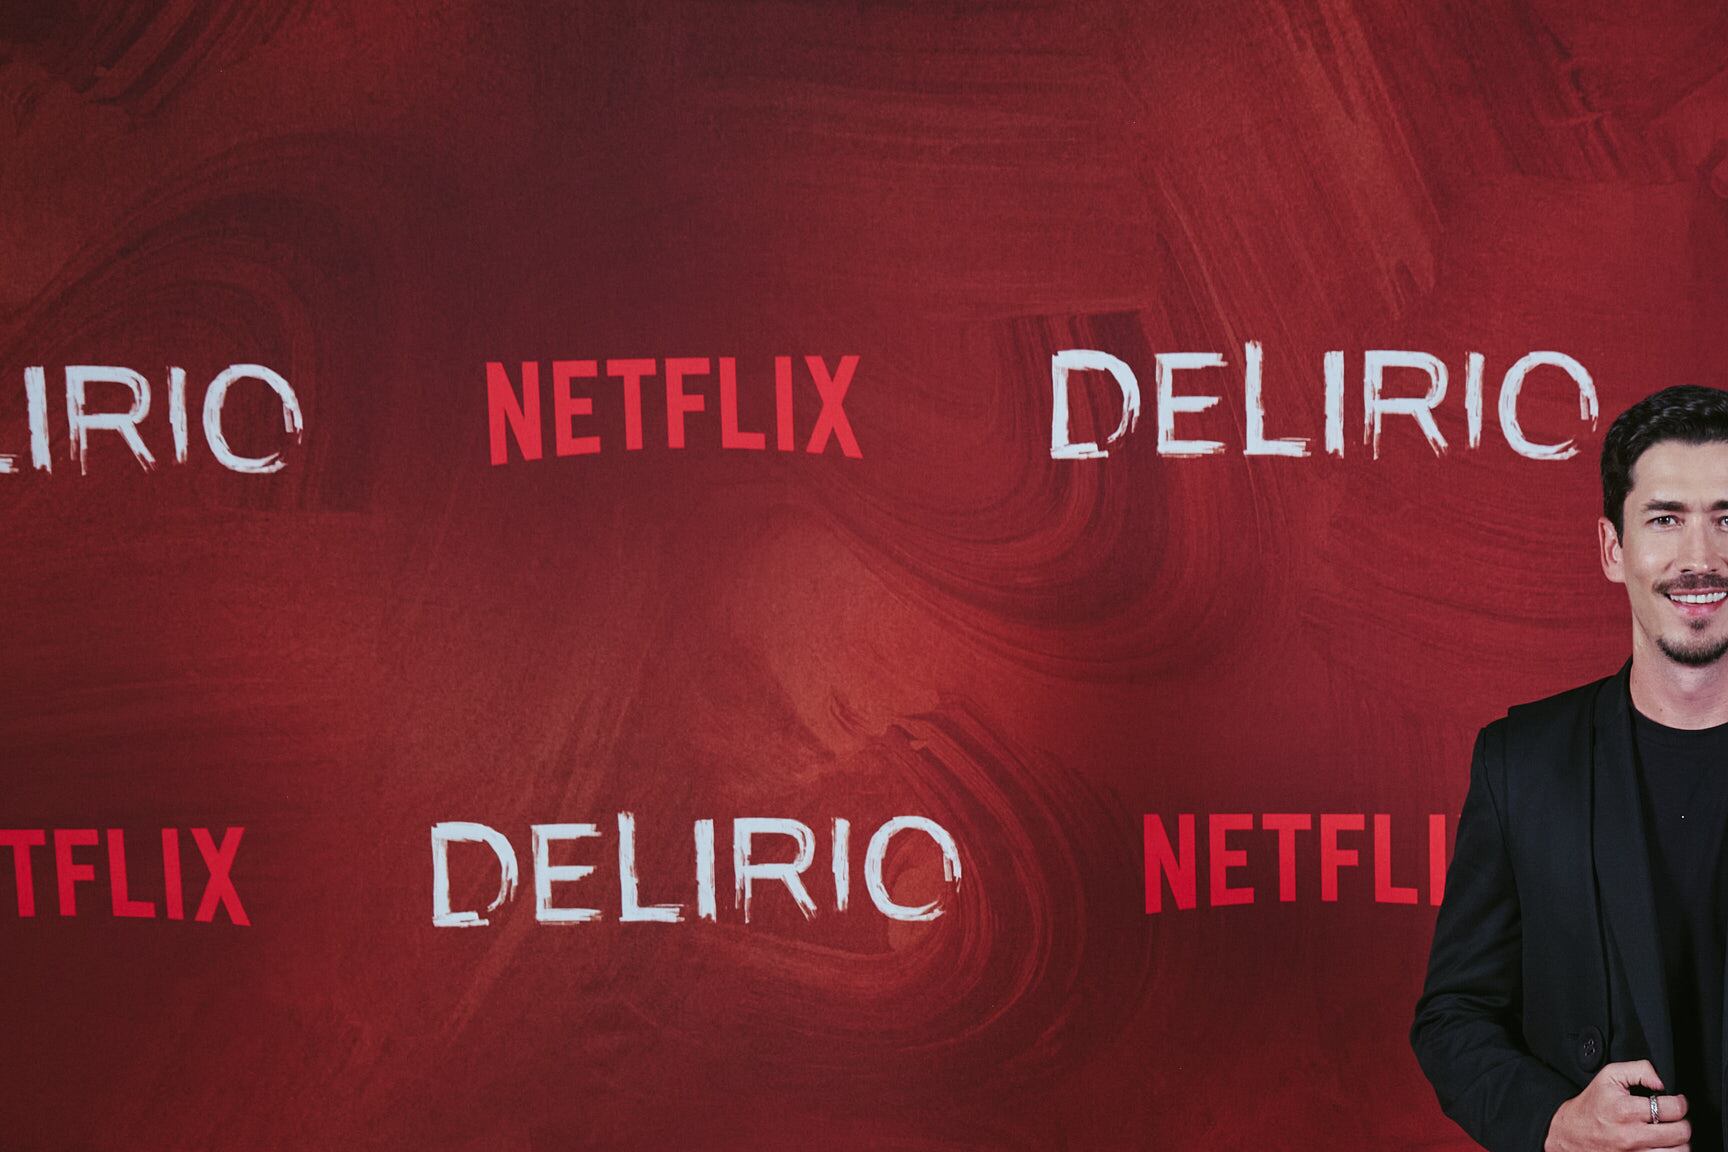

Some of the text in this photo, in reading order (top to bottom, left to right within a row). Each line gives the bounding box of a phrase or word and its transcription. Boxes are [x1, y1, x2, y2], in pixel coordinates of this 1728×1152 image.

[0, 363, 304, 476] IRIO
[485, 354, 864, 466] NETFLIX
[1049, 339, 1602, 462] DELIRIO
[0, 826, 251, 927] TFLIX
[430, 810, 965, 929] DELIRIO
[1143, 812, 1462, 915] NETFLI
